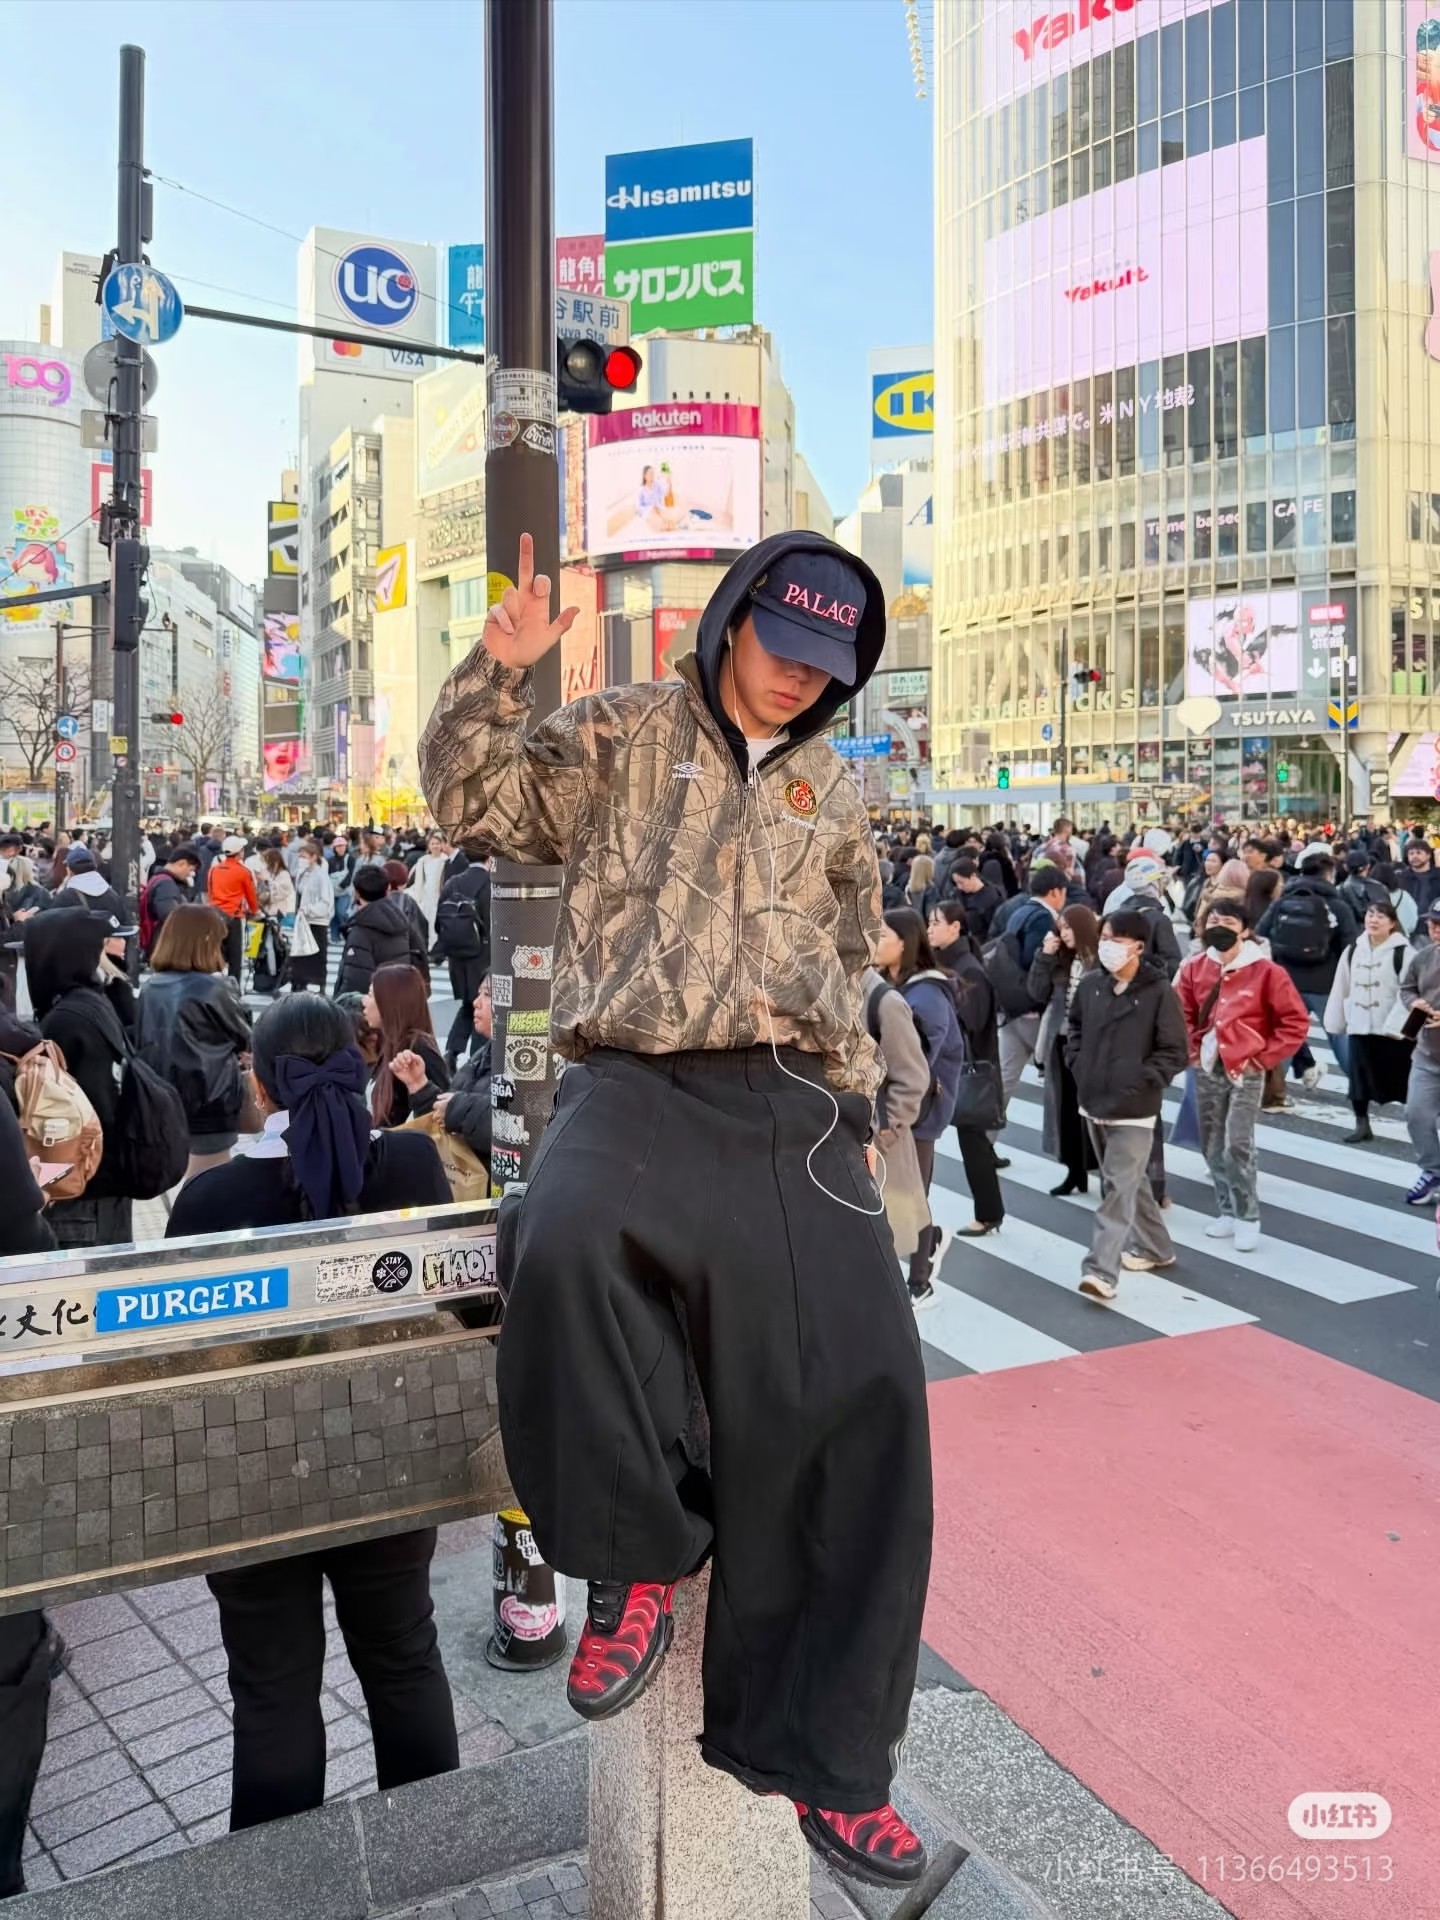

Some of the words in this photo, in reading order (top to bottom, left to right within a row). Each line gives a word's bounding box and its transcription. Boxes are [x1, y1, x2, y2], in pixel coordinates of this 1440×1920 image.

[607, 180, 752, 210] Hisamitsu
[613, 259, 745, 304] サロンパス
[1063, 266, 1150, 304] Yakult
[391, 350, 425, 367] VISA
[4, 353, 72, 405] 109
[632, 410, 702, 429] Rakuten
[1275, 499, 1324, 518] CAFE
[782, 583, 858, 627] PALACE
[1230, 708, 1317, 728] TSUTAYA
[385, 1256, 402, 1265] STAY
[116, 1276, 271, 1323] PURGERI
